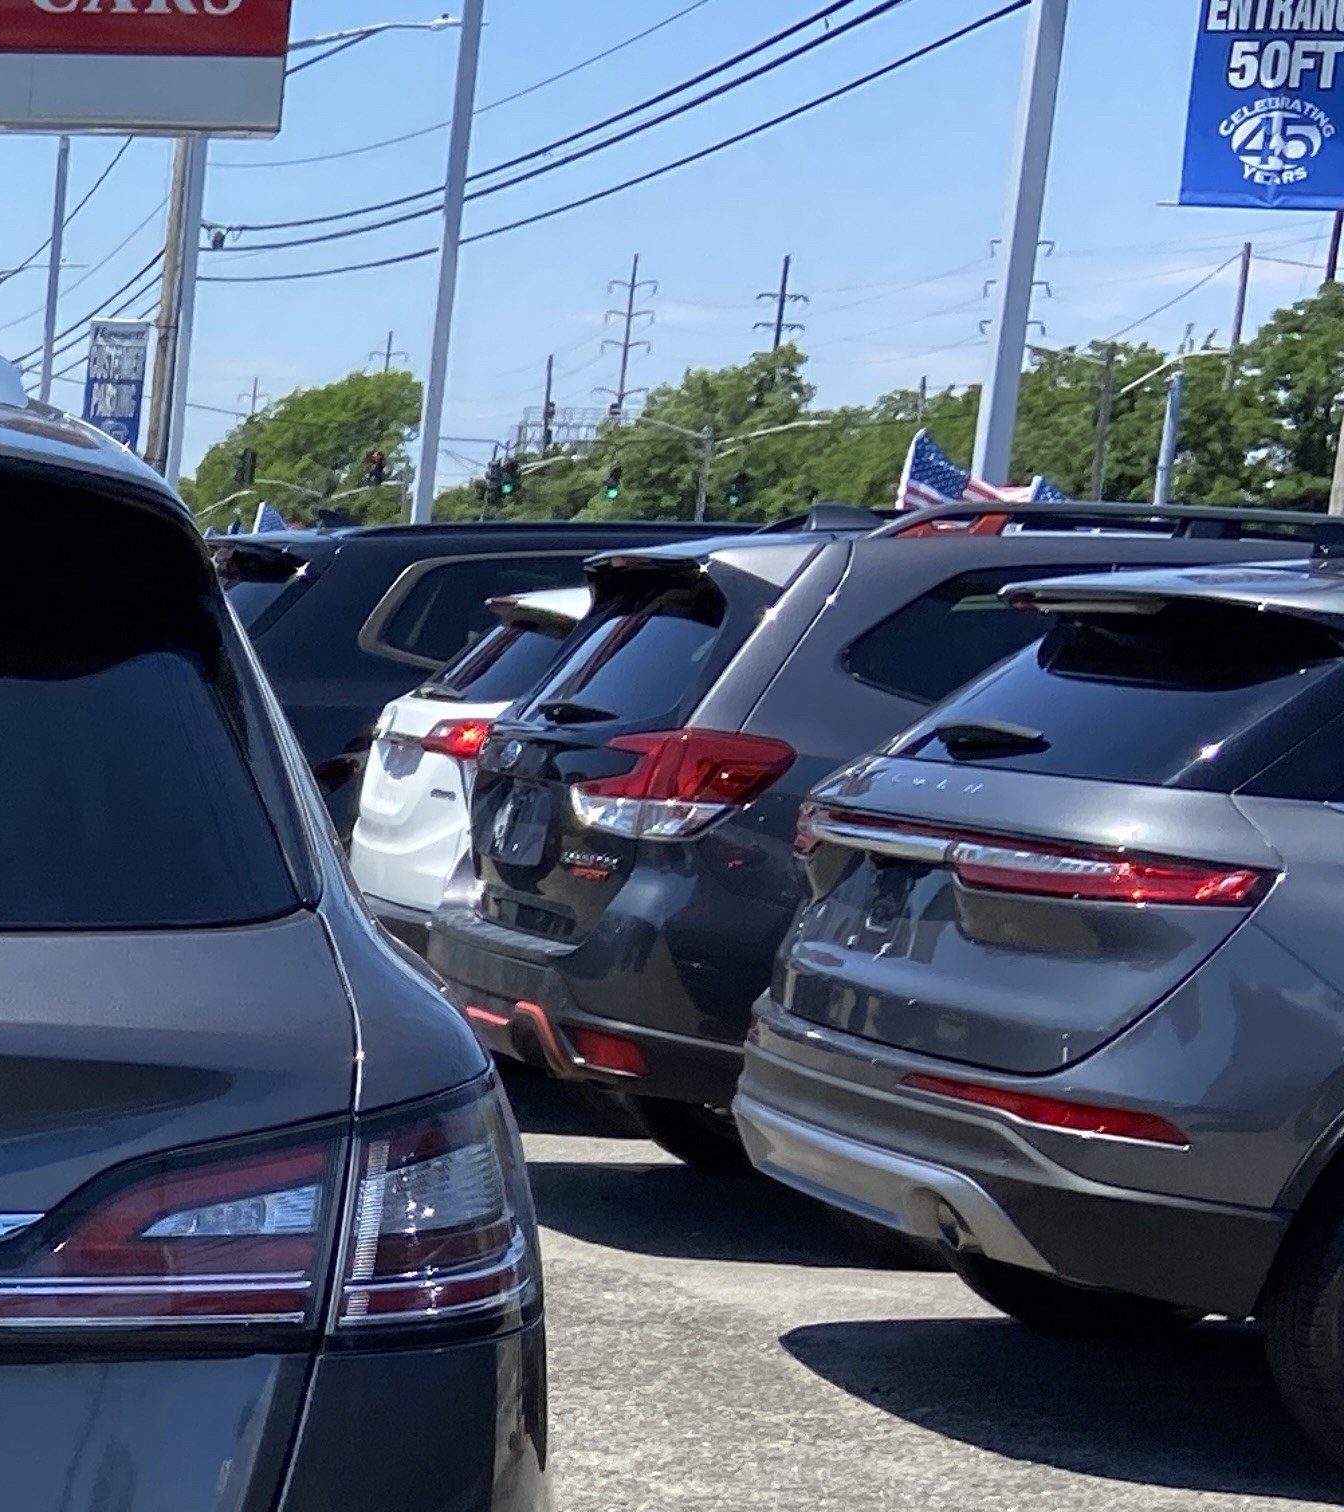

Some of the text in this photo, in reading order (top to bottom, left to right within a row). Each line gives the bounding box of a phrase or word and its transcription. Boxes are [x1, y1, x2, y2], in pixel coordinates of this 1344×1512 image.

[1227, 40, 1344, 89] 50FT
[1218, 97, 1336, 138] CELEBRATING
[1233, 113, 1320, 169] 45
[1242, 165, 1308, 186] YEARS
